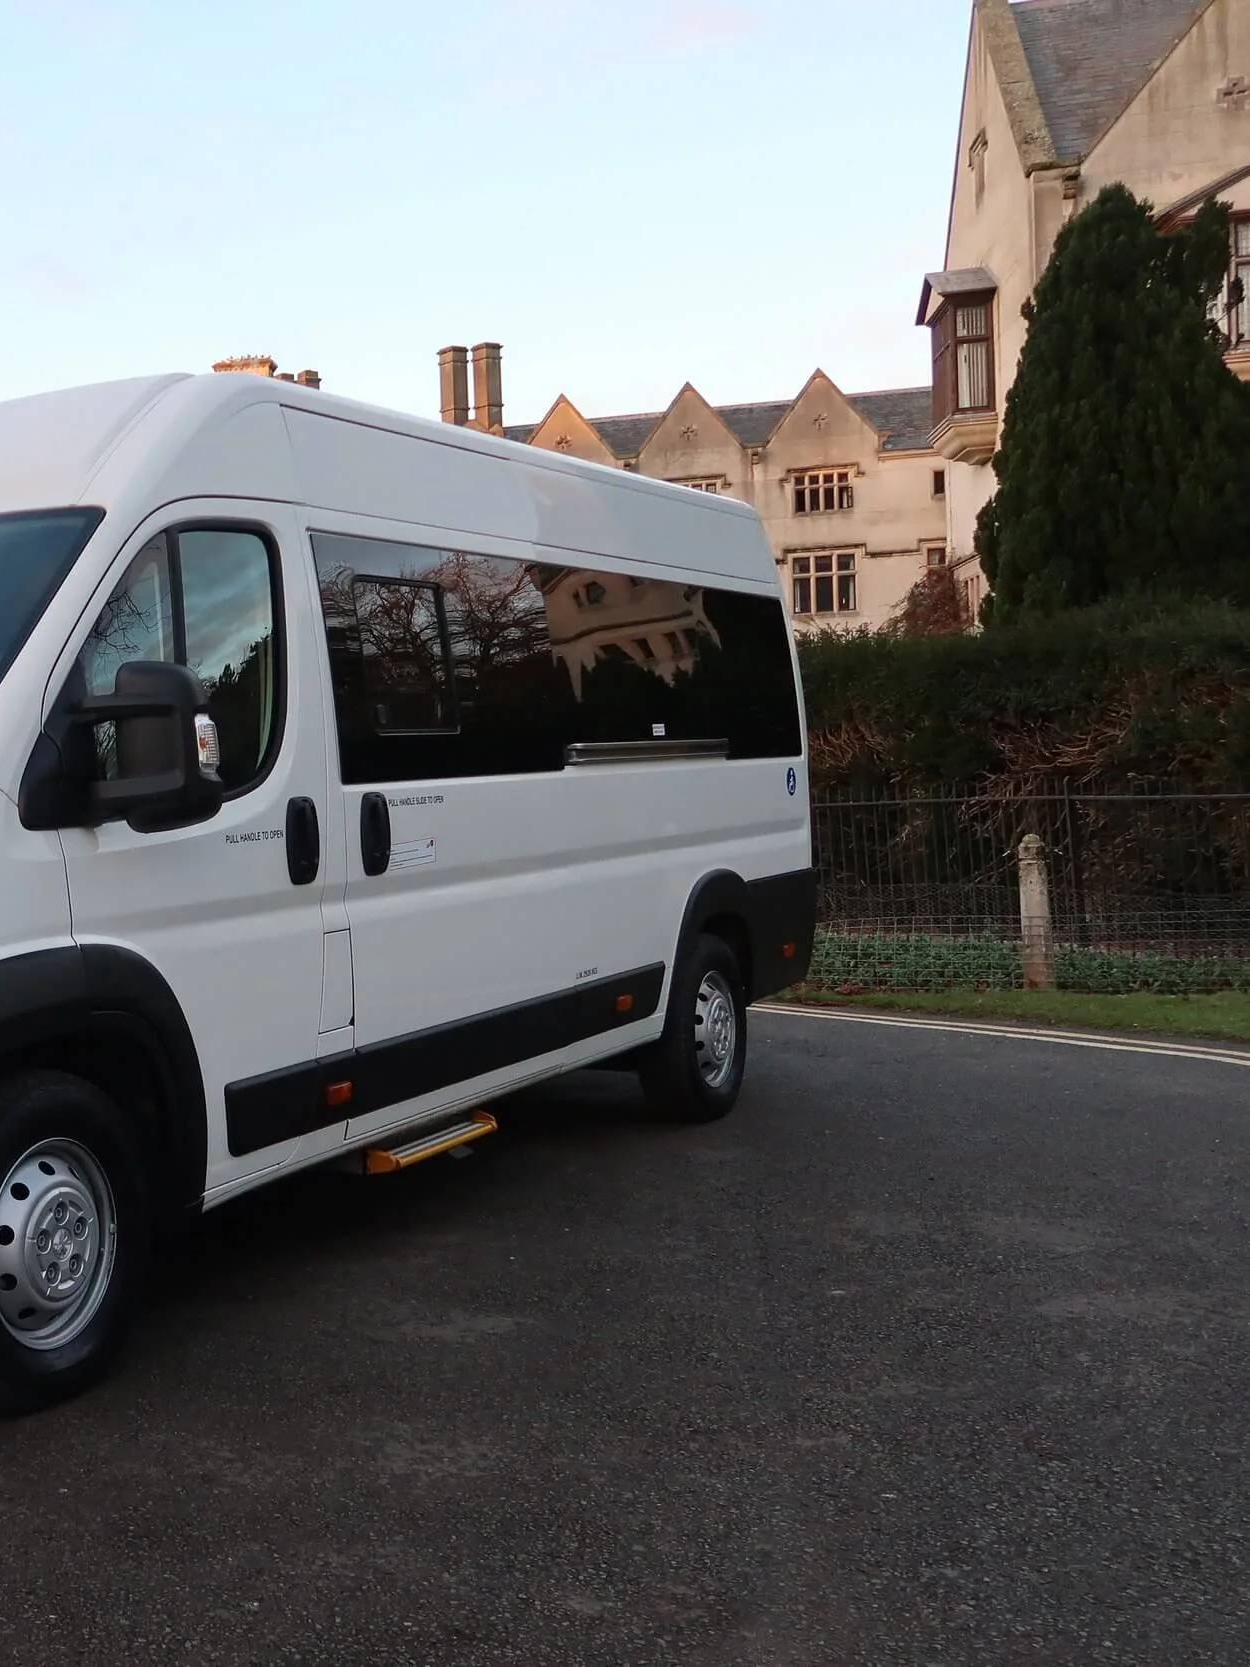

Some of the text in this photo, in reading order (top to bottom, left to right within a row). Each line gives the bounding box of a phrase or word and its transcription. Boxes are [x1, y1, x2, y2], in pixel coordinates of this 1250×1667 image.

[388, 799, 398, 807] PULL
[399, 797, 415, 806] HANDLE
[433, 795, 444, 803] OPEN
[225, 829, 284, 844] PULL HANDLE TO OPEN
